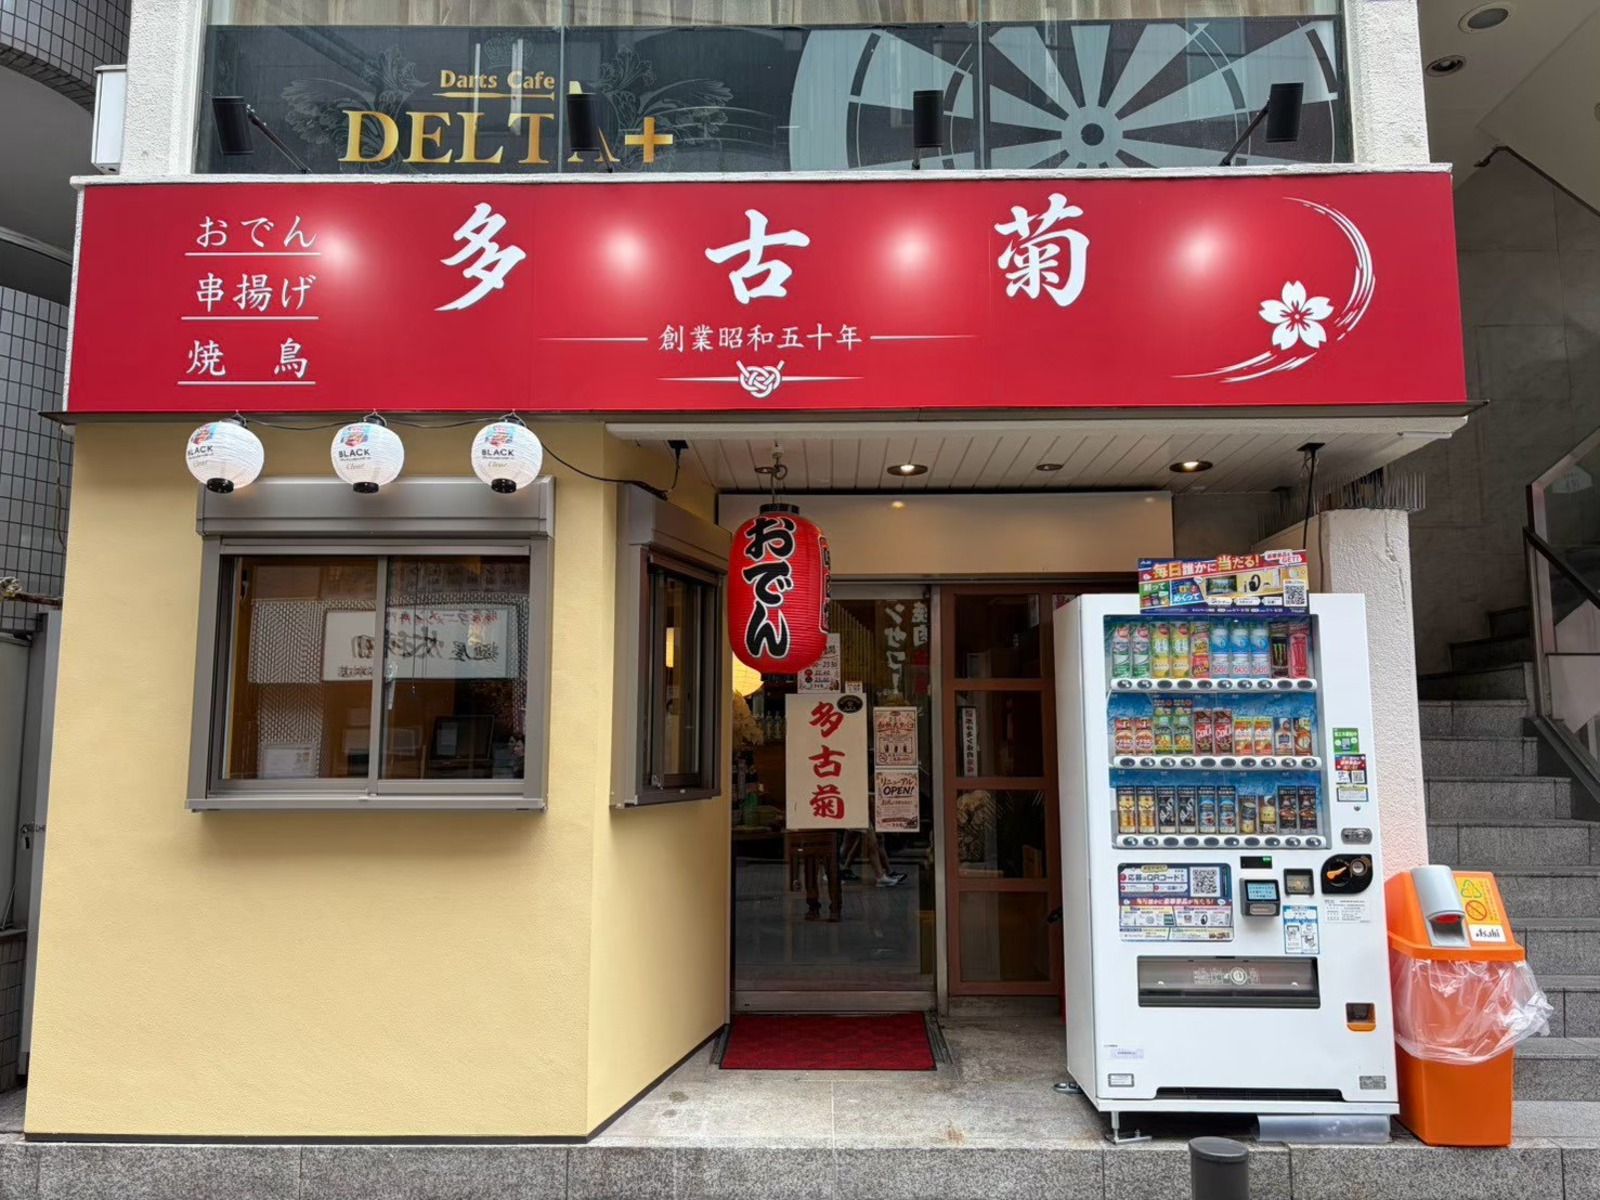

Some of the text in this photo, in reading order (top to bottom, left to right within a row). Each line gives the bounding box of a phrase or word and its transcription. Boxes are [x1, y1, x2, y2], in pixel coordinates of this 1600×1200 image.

[439, 69, 556, 89] Darts Cafe
[196, 215, 317, 249] おでん
[436, 193, 1090, 311] 多古菊
[195, 271, 317, 314] 串揚げ
[659, 324, 862, 353] 創業昭和五十年
[338, 448, 370, 458] BLACK
[742, 516, 797, 659] おでん
[808, 701, 845, 821] 多古菊
[880, 777, 914, 786] リニューアル
[883, 786, 914, 796] OPEN!
[1475, 928, 1501, 938] Asahi
